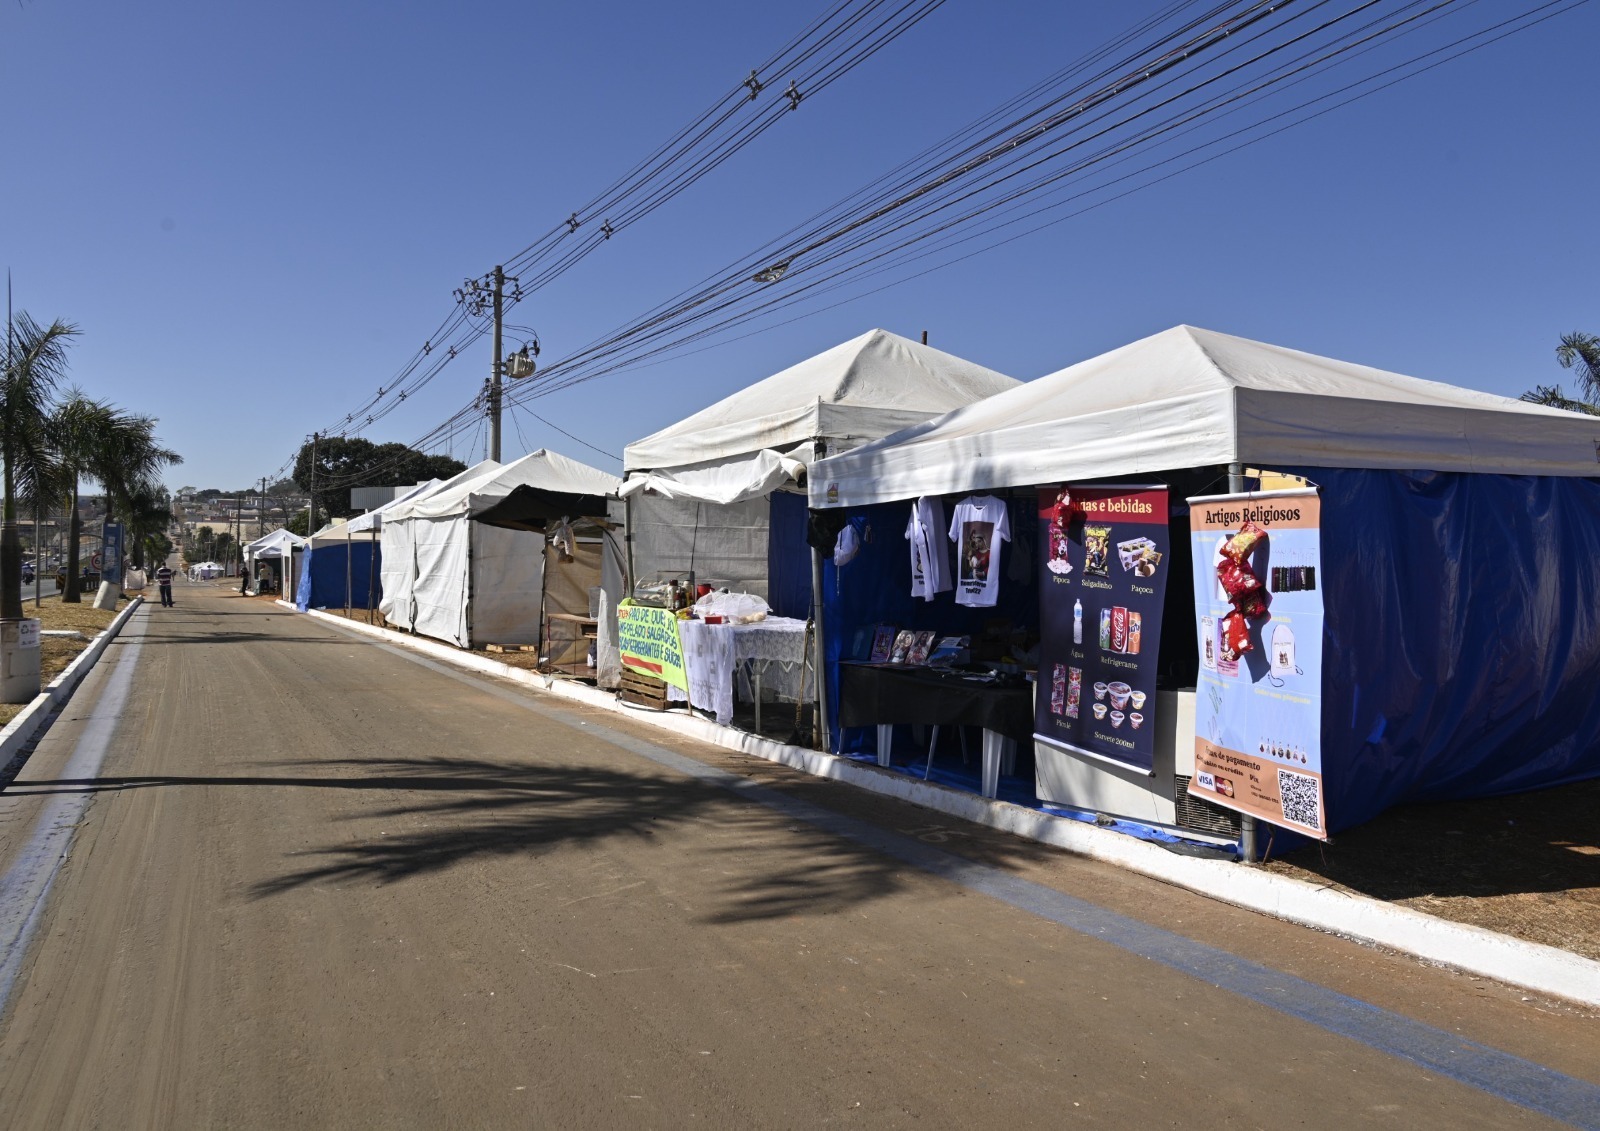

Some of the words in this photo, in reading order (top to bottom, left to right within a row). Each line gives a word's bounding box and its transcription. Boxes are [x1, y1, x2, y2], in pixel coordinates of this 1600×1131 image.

[1099, 502, 1105, 512] e
[1108, 499, 1152, 514] bebidas
[1206, 508, 1240, 527] Artigos
[1243, 505, 1300, 526] Religiosos
[1053, 575, 1071, 584] Pipoca
[1081, 579, 1112, 590] Salgadinho
[1131, 584, 1153, 594] Paçoca
[1101, 655, 1138, 670] Refrigerante
[1094, 731, 1115, 744] Sorvete
[1115, 735, 1135, 749] 200ml
[1218, 751, 1225, 761] de
[1226, 754, 1261, 771] pagamento
[1198, 774, 1213, 787] VISA
